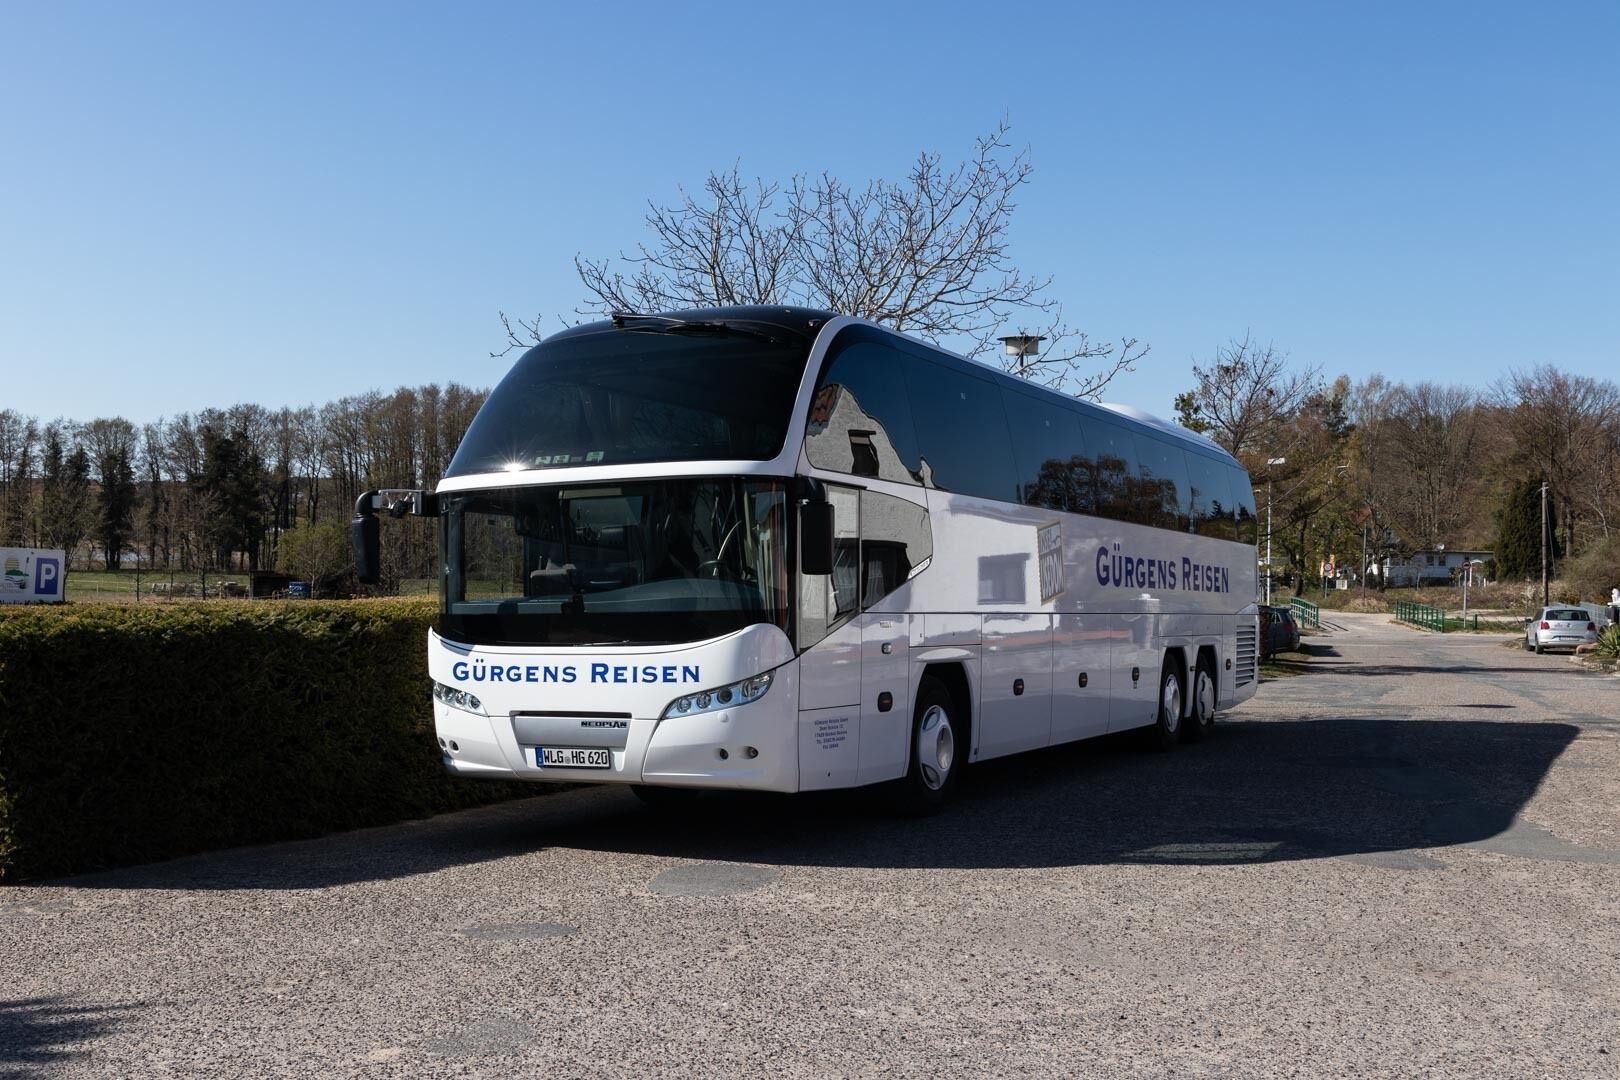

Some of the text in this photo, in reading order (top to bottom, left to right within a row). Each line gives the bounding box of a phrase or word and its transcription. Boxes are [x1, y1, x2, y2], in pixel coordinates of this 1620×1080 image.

[40, 563, 56, 589] P
[1096, 542, 1229, 593] GÜRGENS REISEN
[452, 658, 700, 683] GÜRGENS REISEN
[581, 720, 627, 728] NEOPLAN
[543, 750, 608, 765] WLG HG 620
